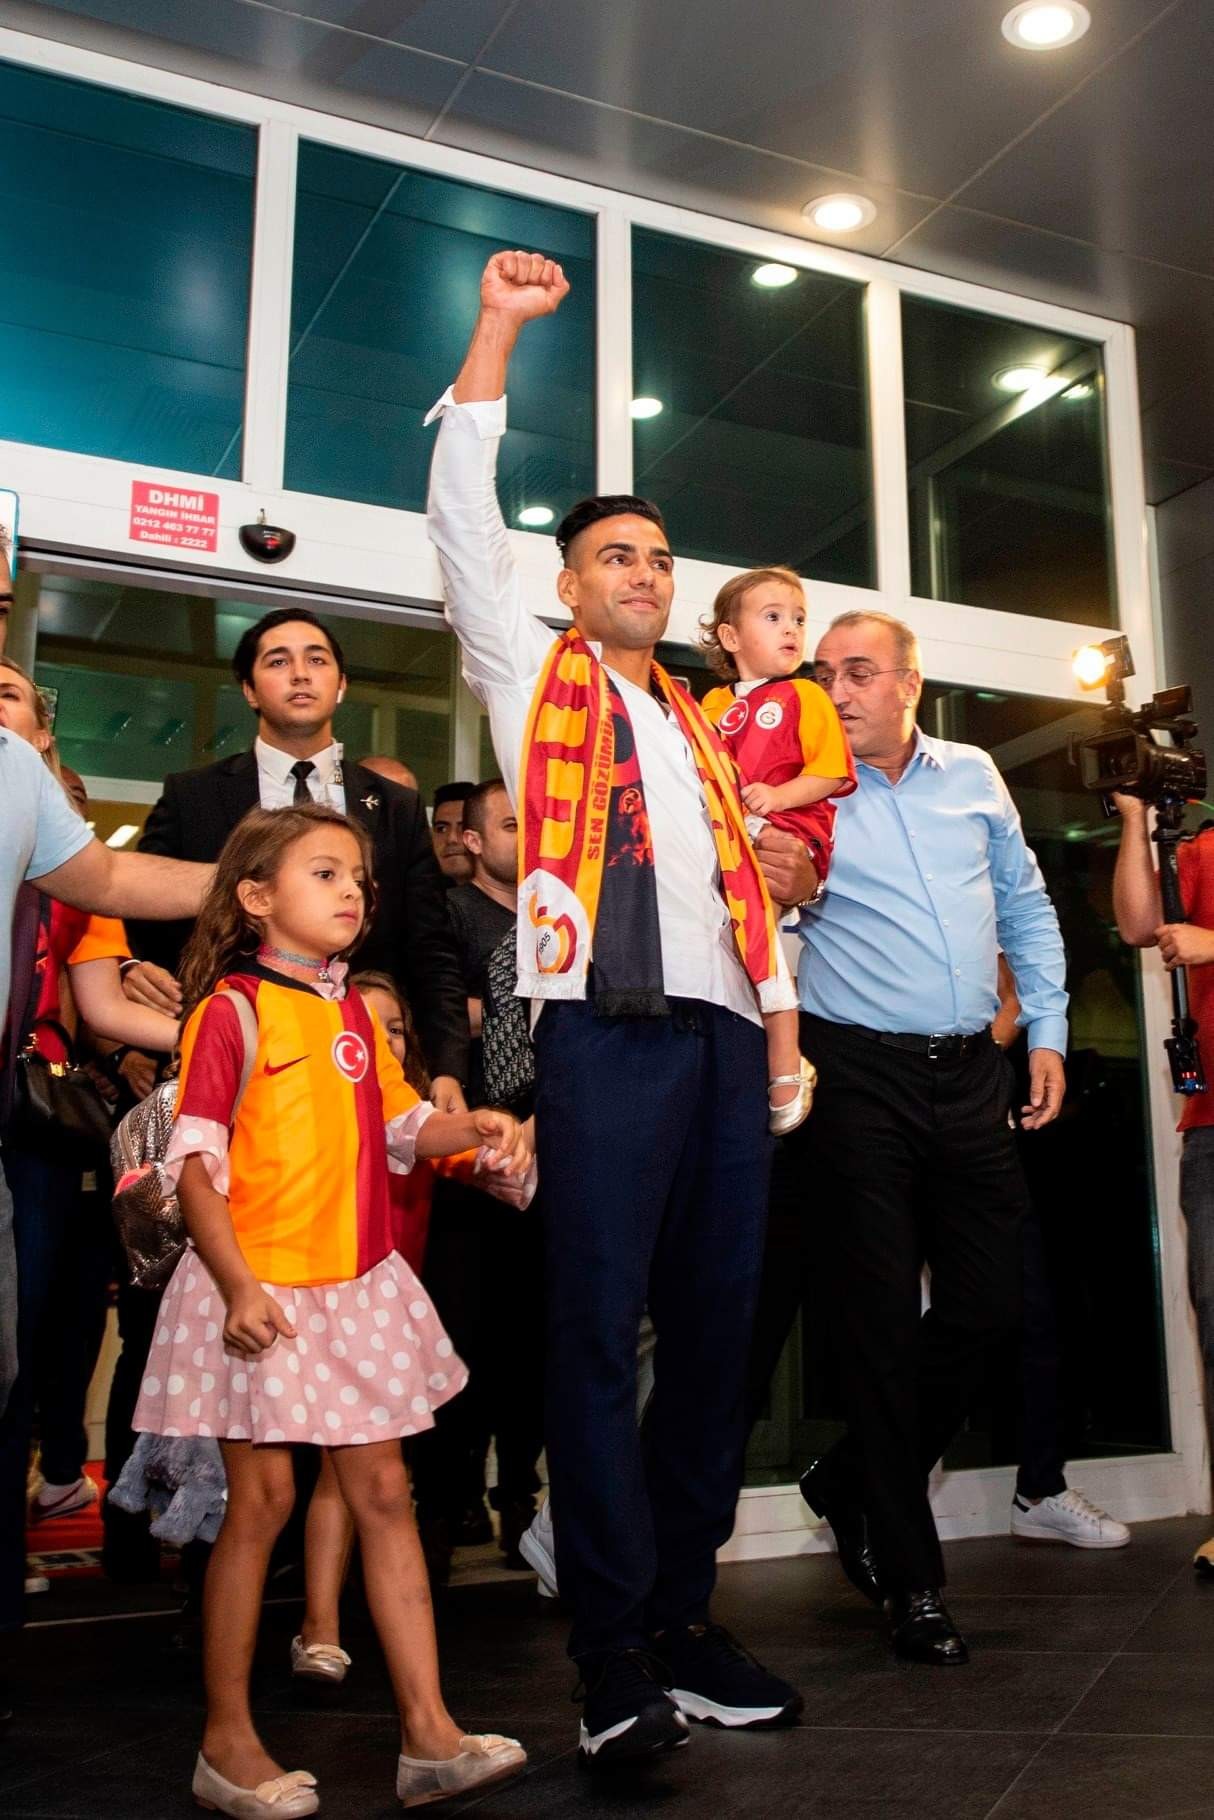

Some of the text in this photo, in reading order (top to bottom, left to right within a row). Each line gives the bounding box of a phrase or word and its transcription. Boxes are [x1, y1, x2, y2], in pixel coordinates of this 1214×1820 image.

[135, 504, 178, 518] YANGIN
[133, 517, 160, 528] 0212
[185, 525, 199, 534] 77
[201, 528, 215, 537] 77
[140, 530, 171, 543] Dahili
[181, 536, 207, 548] 2222
[587, 817, 604, 861] SEN
